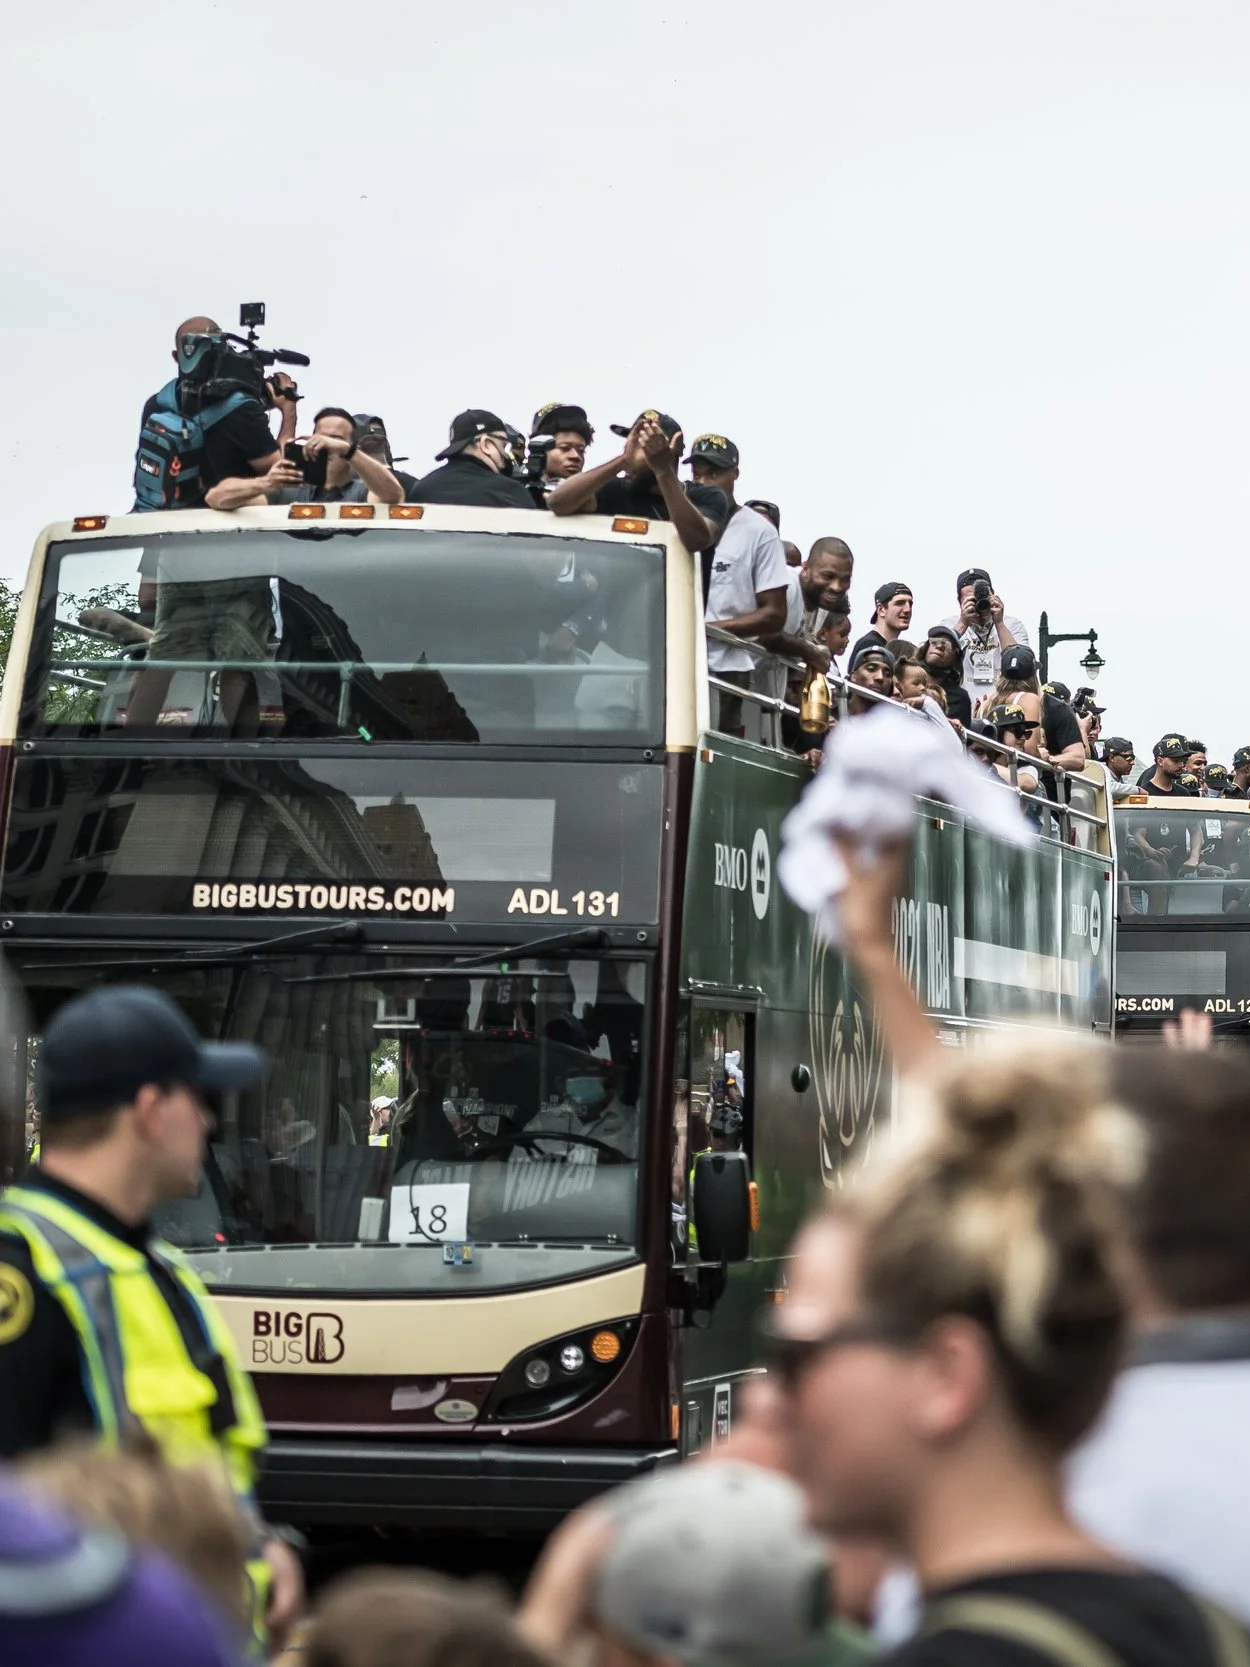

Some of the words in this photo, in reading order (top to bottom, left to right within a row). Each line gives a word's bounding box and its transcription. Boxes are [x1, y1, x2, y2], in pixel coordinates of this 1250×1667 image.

[714, 842, 748, 891] BMO
[192, 884, 454, 912] BIGBUSTOURS.COM
[507, 888, 567, 915] ADL
[570, 890, 620, 917] 131
[1071, 903, 1089, 937] BMO
[891, 896, 921, 1005] 2021
[926, 902, 950, 1010] NBA
[1204, 999, 1235, 1013] ADL
[409, 1204, 447, 1234] 18
[253, 1310, 303, 1338] BIG
[252, 1339, 303, 1364] BUS
